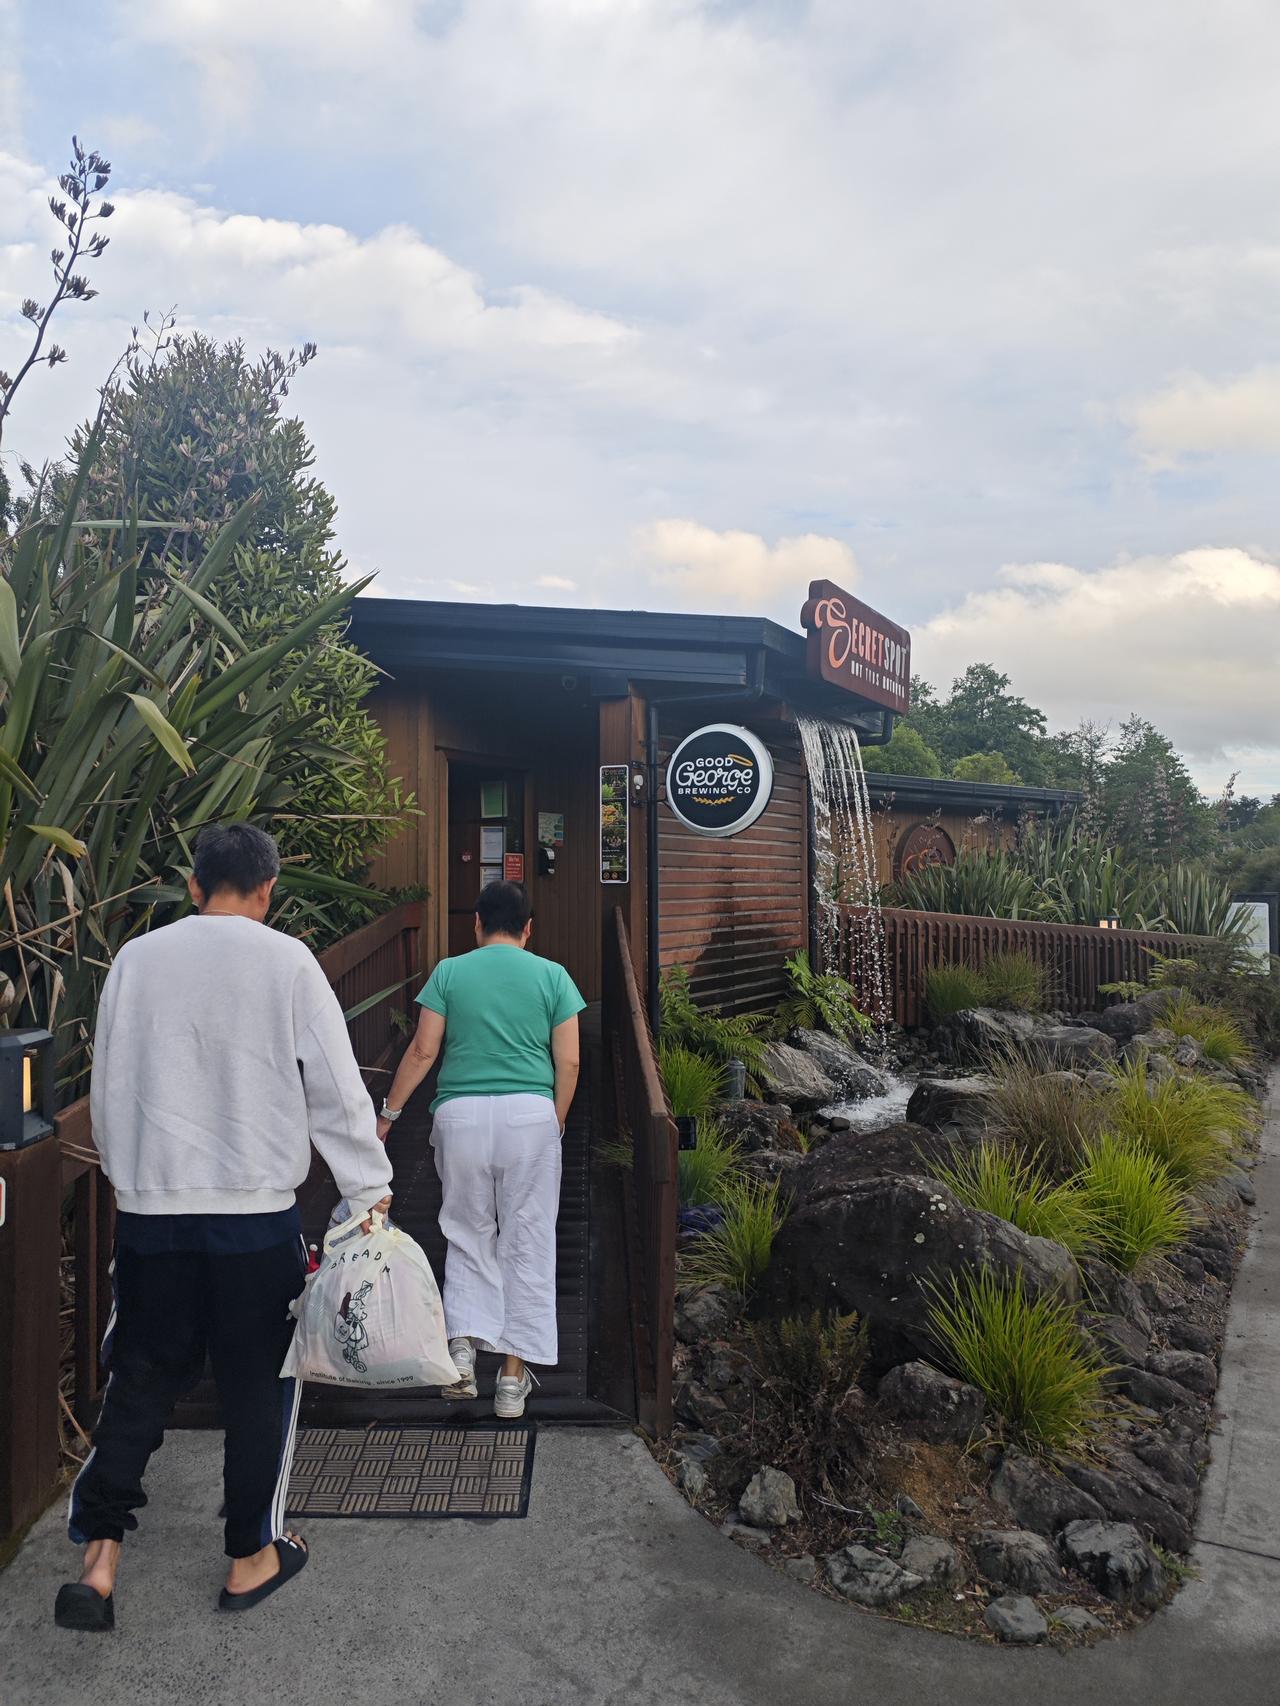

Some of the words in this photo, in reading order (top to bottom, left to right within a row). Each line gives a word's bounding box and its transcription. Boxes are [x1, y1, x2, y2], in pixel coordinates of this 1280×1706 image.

[695, 757, 734, 767] GOOD
[676, 761, 754, 791] George
[677, 787, 728, 795] BREWING
[736, 786, 752, 794] CO
[396, 1375, 414, 1383] 1999
